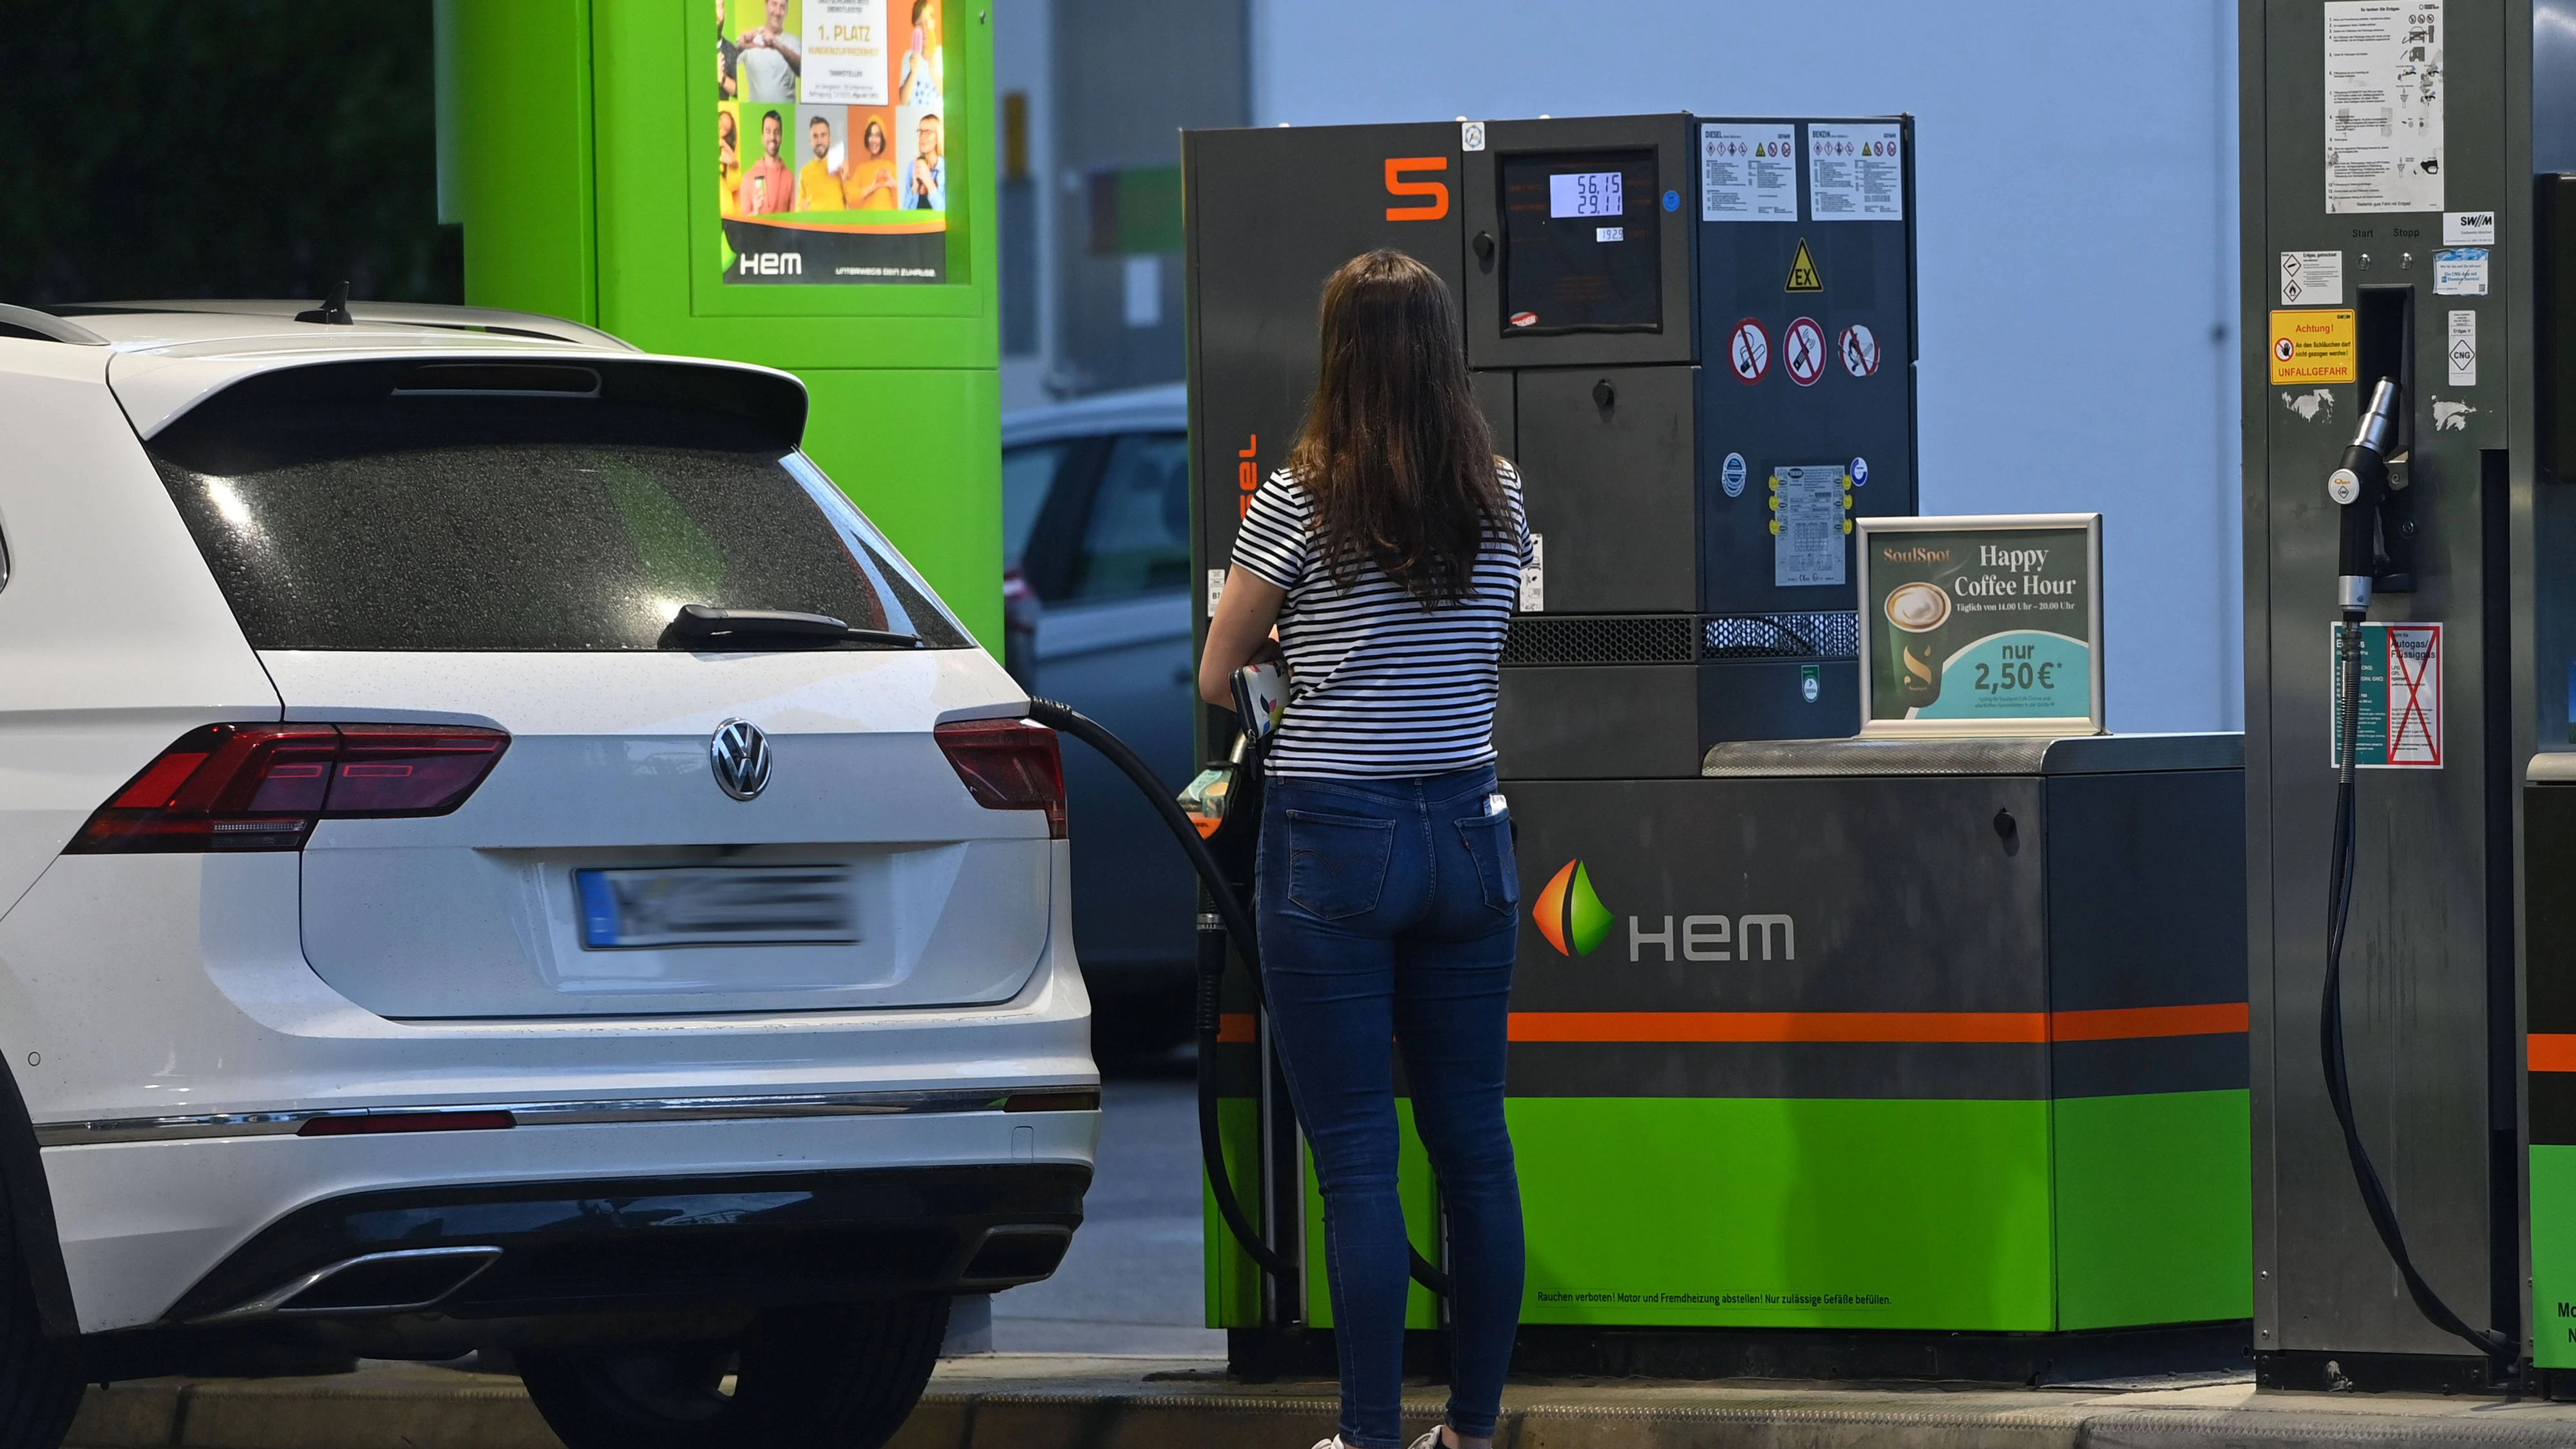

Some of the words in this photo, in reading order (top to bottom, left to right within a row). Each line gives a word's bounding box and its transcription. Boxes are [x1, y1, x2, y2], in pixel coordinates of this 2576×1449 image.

[834, 24, 871, 42] PLATZ
[1385, 156, 1450, 222] 5
[1577, 175, 1620, 194] 56,15
[1577, 195, 1620, 214] 29,11
[2353, 229, 2373, 238] Start
[2393, 228, 2420, 238] Stopp
[1795, 269, 1812, 285] EX
[2296, 324, 2334, 334] Achtung!
[2278, 367, 2347, 377] UNFALLGEFAHR
[1884, 547, 1951, 565] SoulSpot
[1980, 545, 2049, 572] Happy
[1955, 574, 2017, 596] Coffee
[2023, 575, 2077, 595] Hour
[1956, 603, 1982, 613] Täglich
[2017, 602, 2031, 611] Uhr
[2060, 601, 2075, 610] Uhr
[2002, 645, 2034, 659] nur
[1538, 1291, 1573, 1302] Rauchen
[1575, 1292, 1615, 1302] verboten!
[1618, 1293, 1641, 1302] Motor
[1643, 1293, 1659, 1303] und
[1661, 1293, 1720, 1306] Fremdheizung
[1721, 1293, 1763, 1304] abstellen!
[1765, 1294, 1780, 1304] Nur
[1782, 1294, 1822, 1307] zulässige
[1824, 1294, 1853, 1304] Gefäße
[1855, 1294, 1892, 1305] befüllen.
